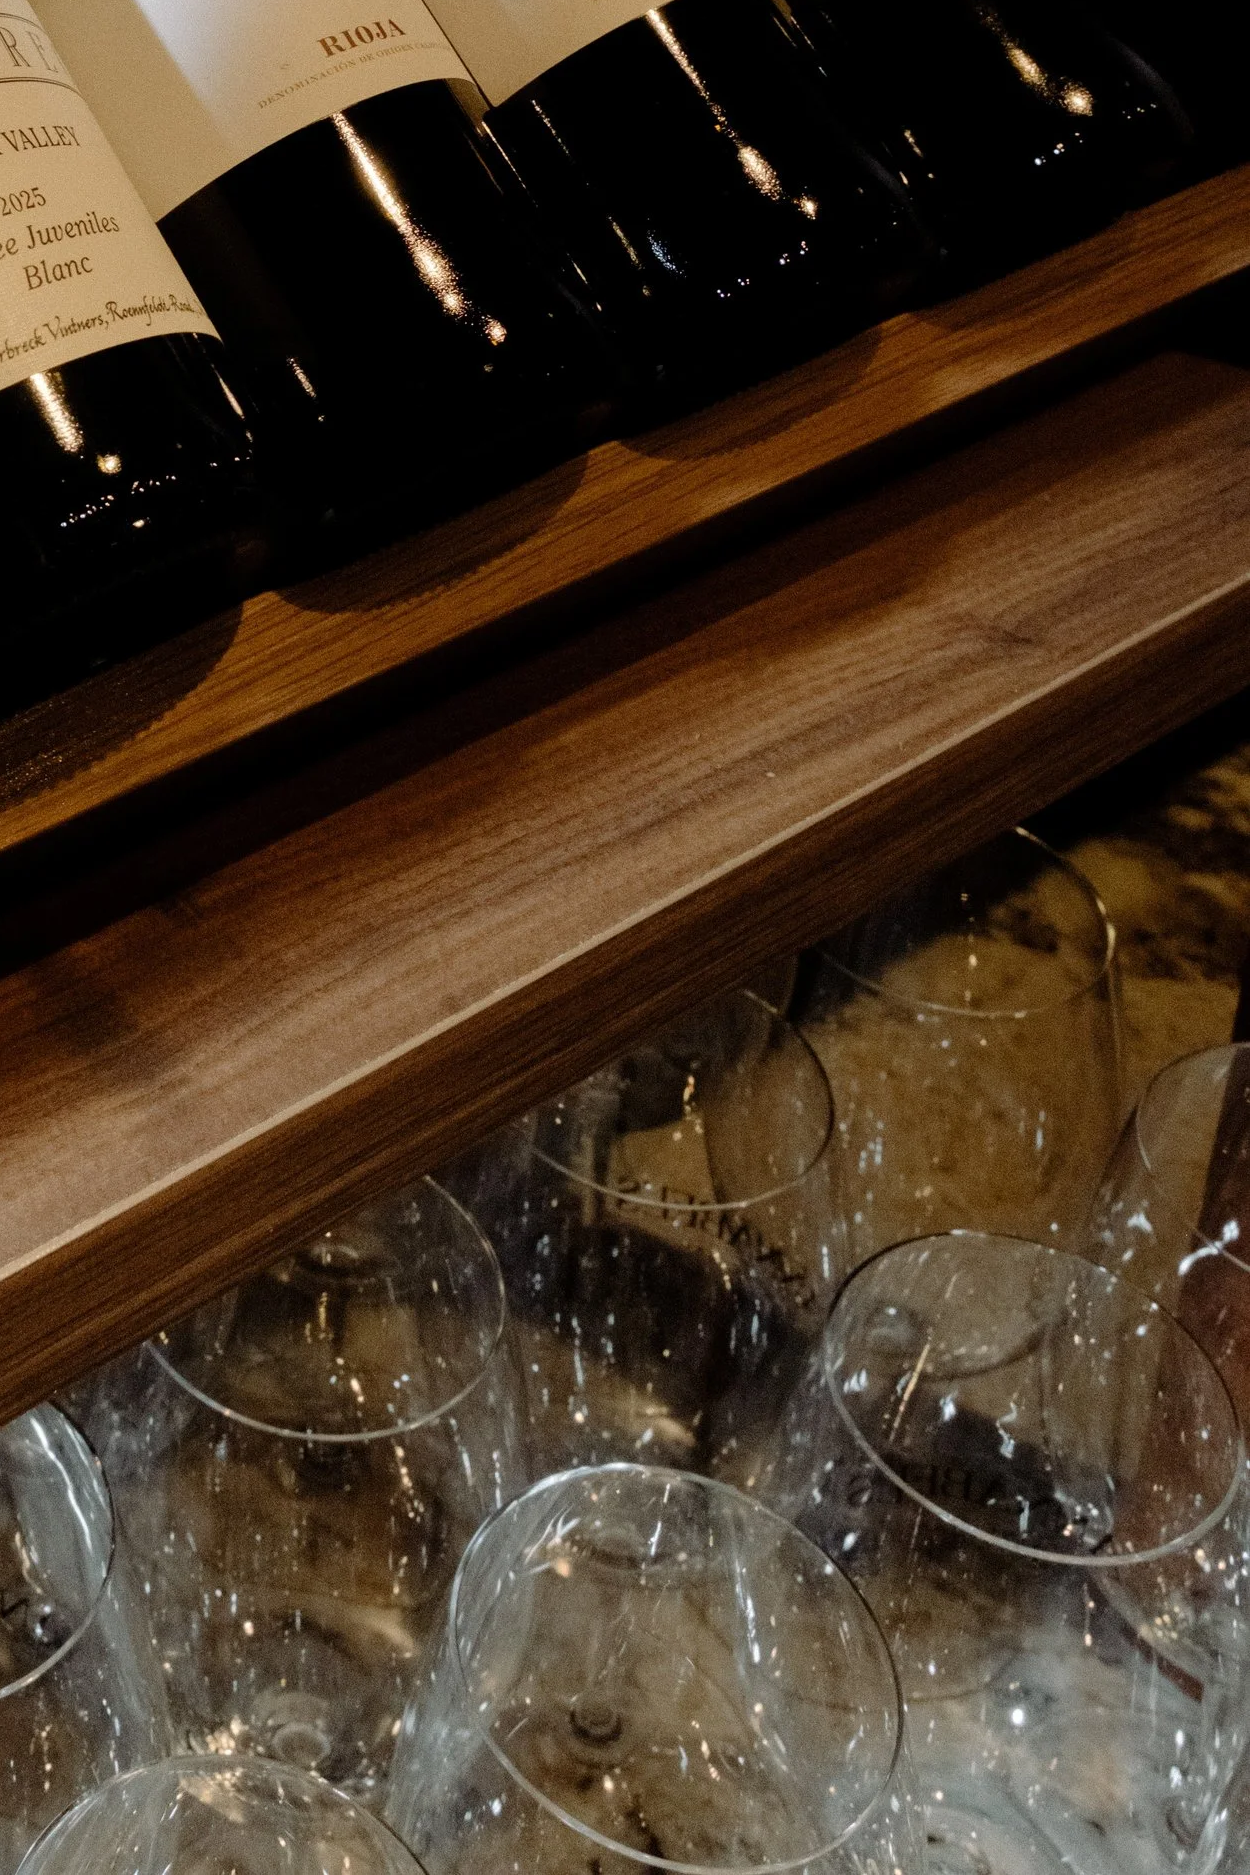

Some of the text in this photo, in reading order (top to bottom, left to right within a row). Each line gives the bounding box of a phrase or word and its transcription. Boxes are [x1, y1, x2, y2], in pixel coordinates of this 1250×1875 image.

[316, 18, 407, 59] RIOJA
[257, 57, 356, 110] DENOMINACIÓN
[357, 53, 375, 65] DE
[0, 124, 82, 154] VALLEY
[25, 210, 121, 250] Juveniles
[22, 255, 94, 291] Blanc
[43, 315, 110, 342] Vintners,
